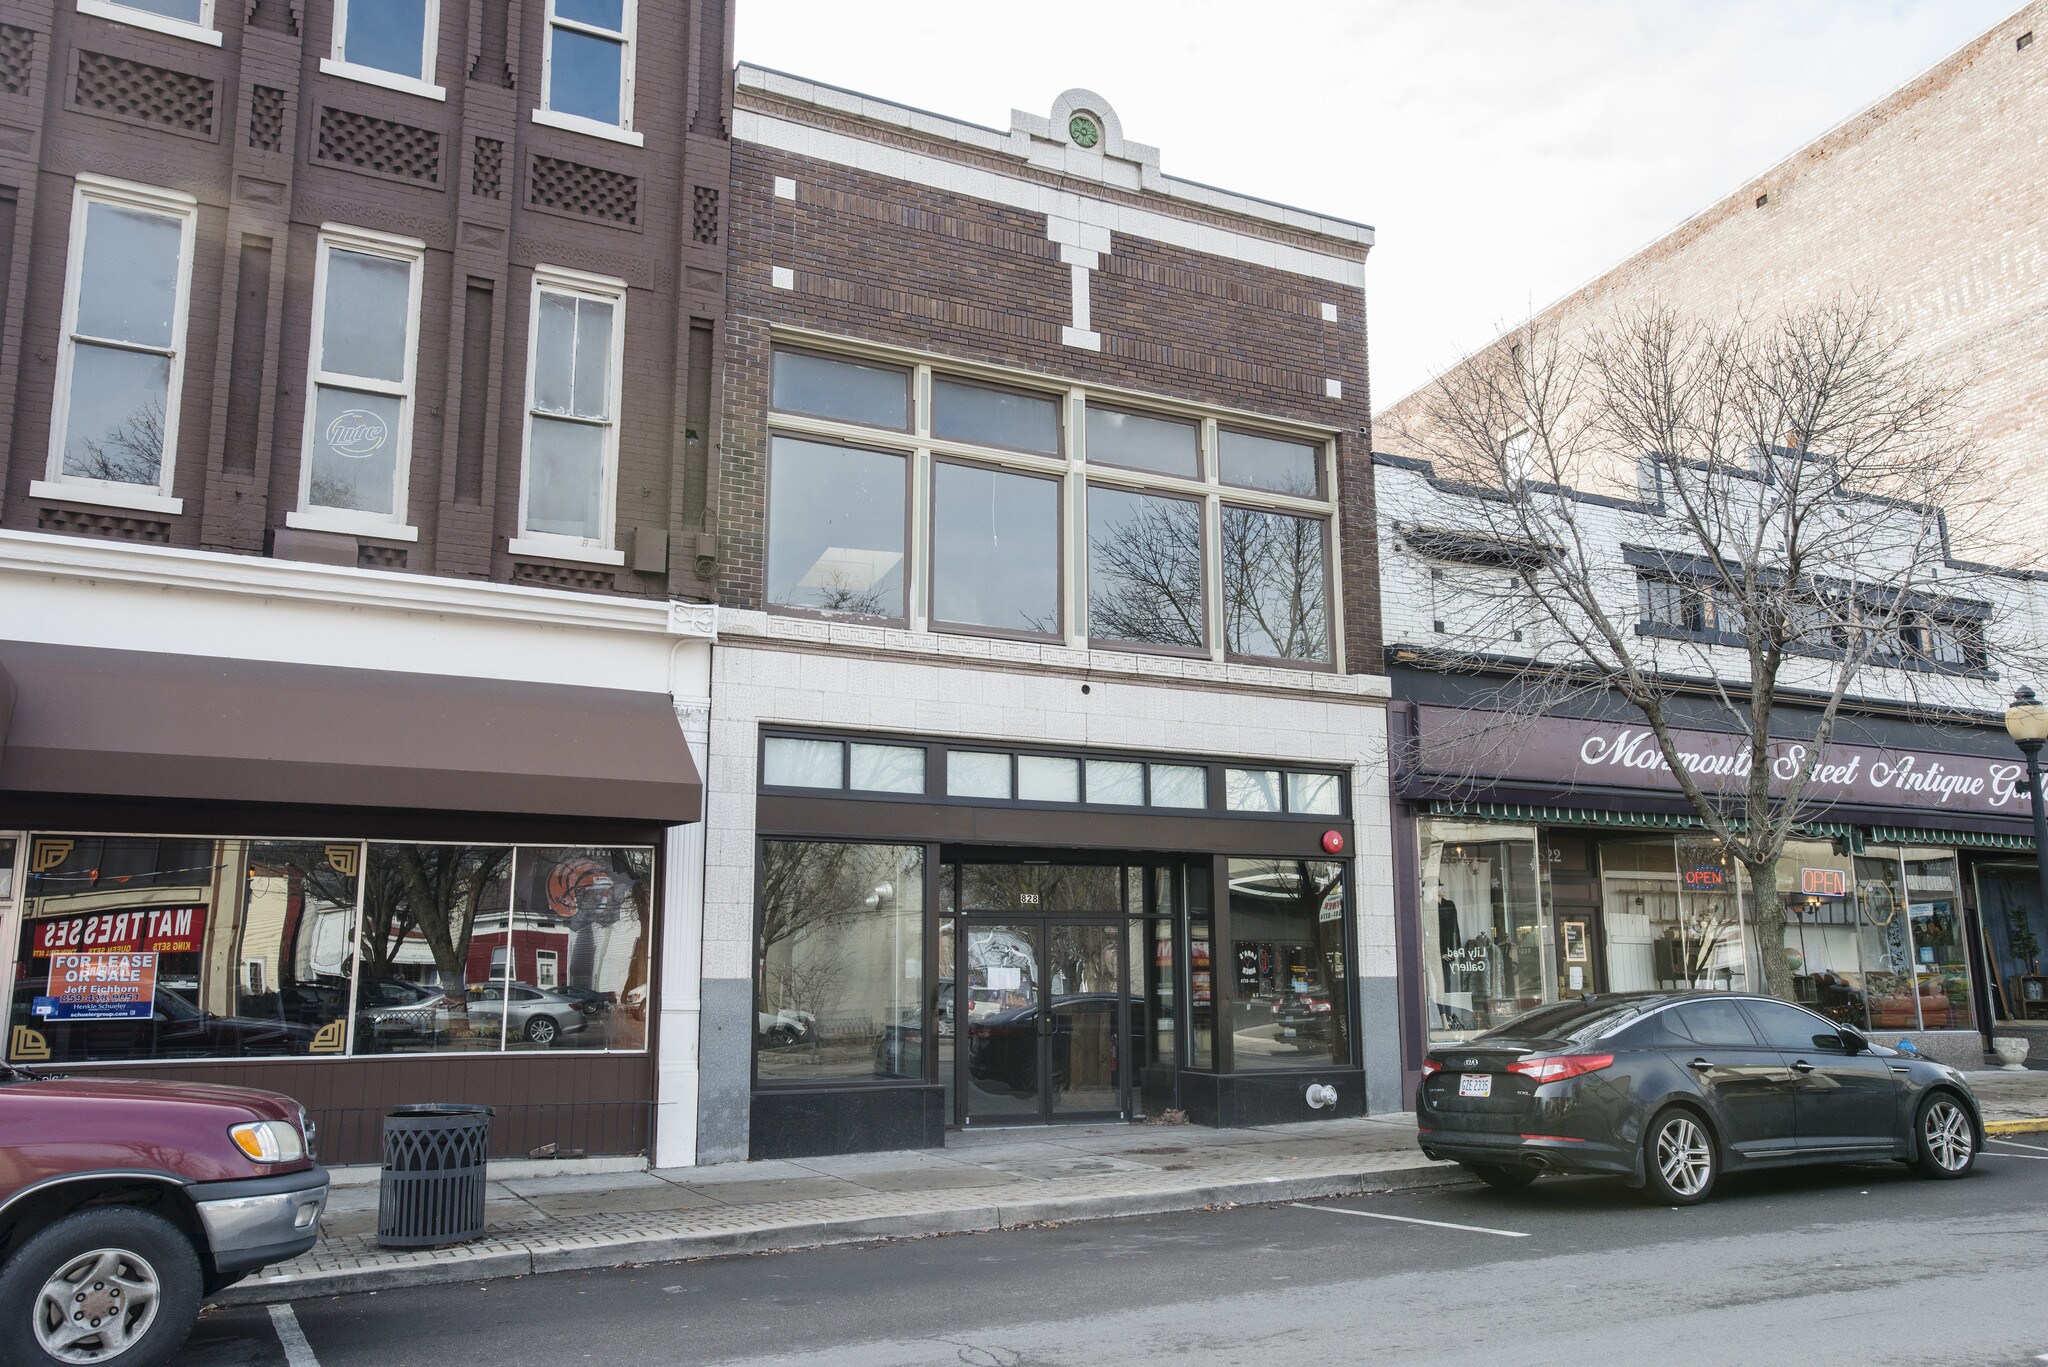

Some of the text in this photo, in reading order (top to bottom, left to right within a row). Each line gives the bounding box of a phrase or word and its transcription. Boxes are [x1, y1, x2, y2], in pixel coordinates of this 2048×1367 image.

[1581, 730, 1753, 777] Monmout
[1773, 745, 1861, 784] Sreet
[1870, 756, 1984, 802] Antique
[1685, 871, 1722, 884] OPEN
[1803, 870, 1845, 895] OPEN
[1021, 894, 1038, 903] 828
[55, 956, 91, 968] FOR
[97, 956, 153, 968] LEASE
[65, 970, 141, 983] OR SALE
[64, 985, 139, 994] Jeff Eichhorn
[70, 1010, 128, 1018] schuelergroup.com
[1461, 1080, 1472, 1091] GZE
